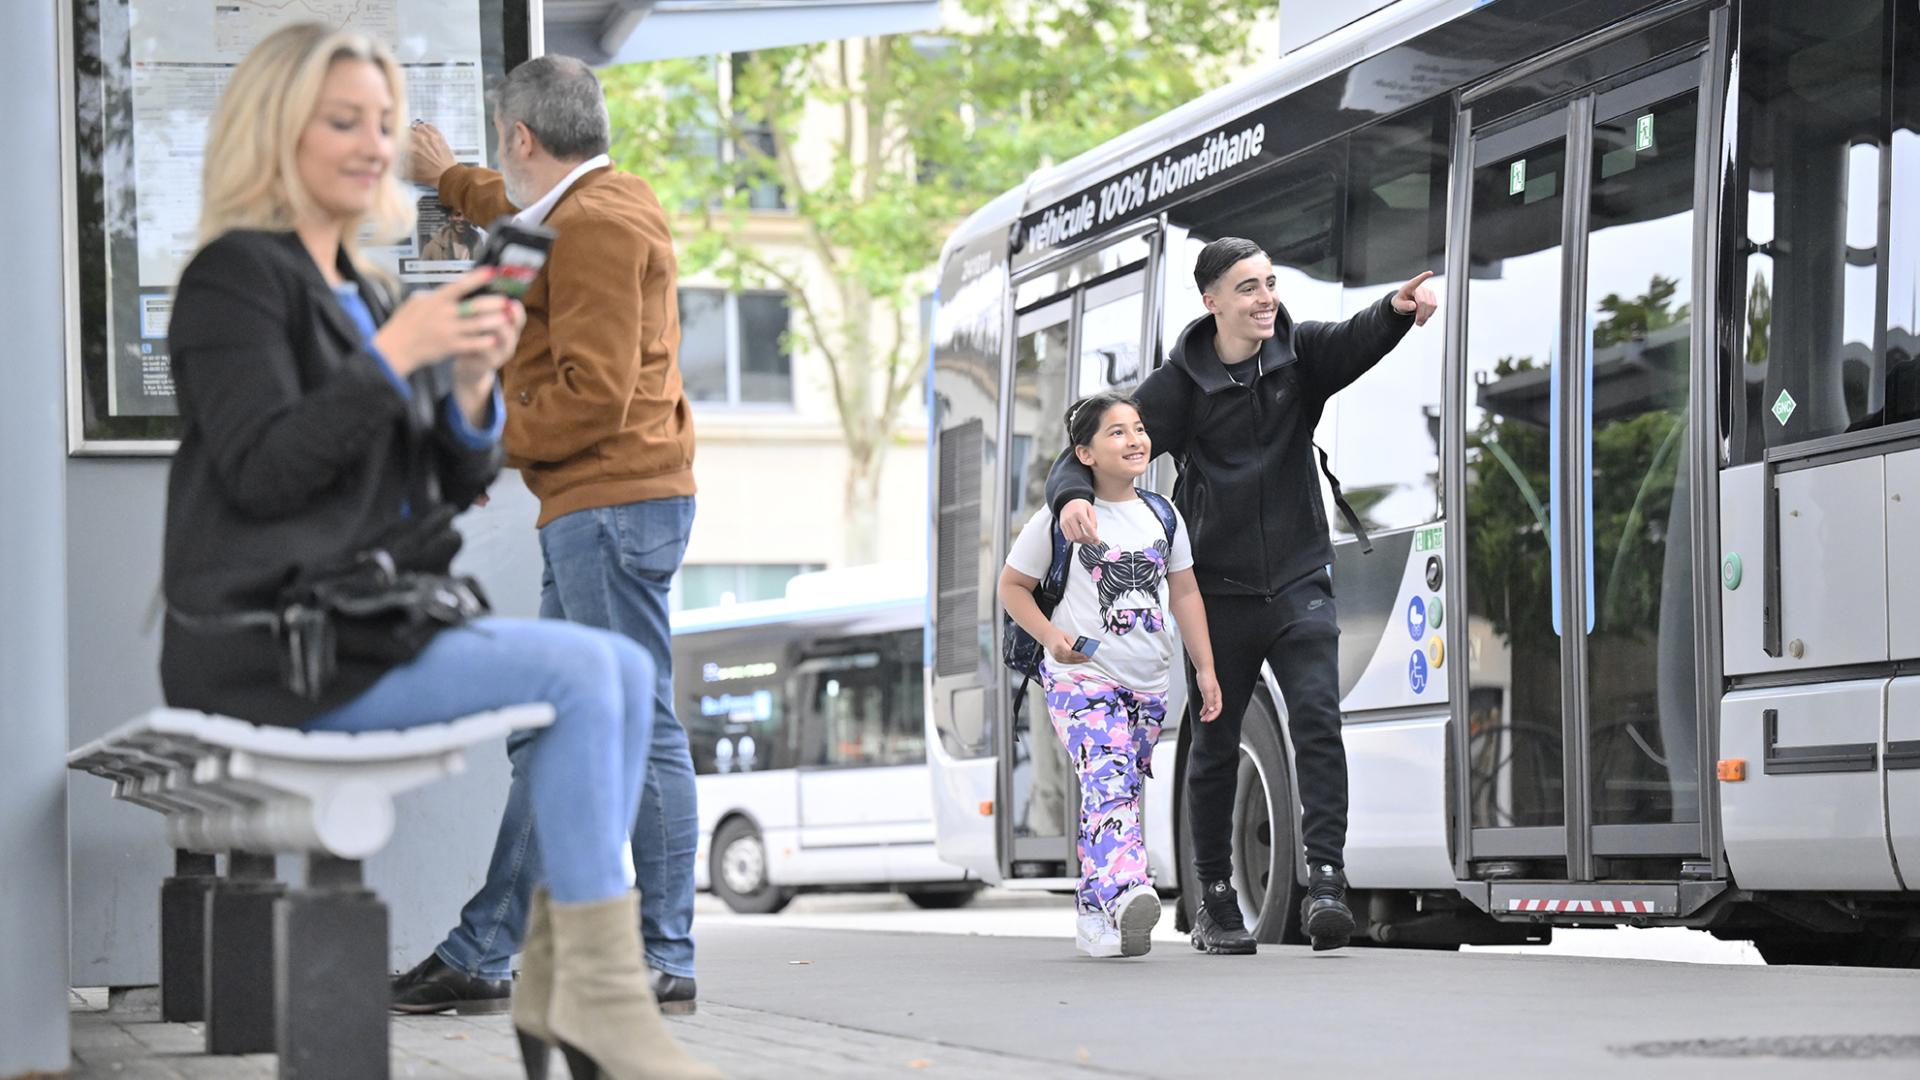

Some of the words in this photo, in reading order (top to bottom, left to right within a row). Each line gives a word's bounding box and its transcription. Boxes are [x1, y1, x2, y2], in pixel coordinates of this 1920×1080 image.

[1029, 195, 1096, 253] véhicule
[1098, 168, 1148, 224] 100%
[1148, 123, 1265, 202] biométhane
[1776, 400, 1793, 415] GNC
